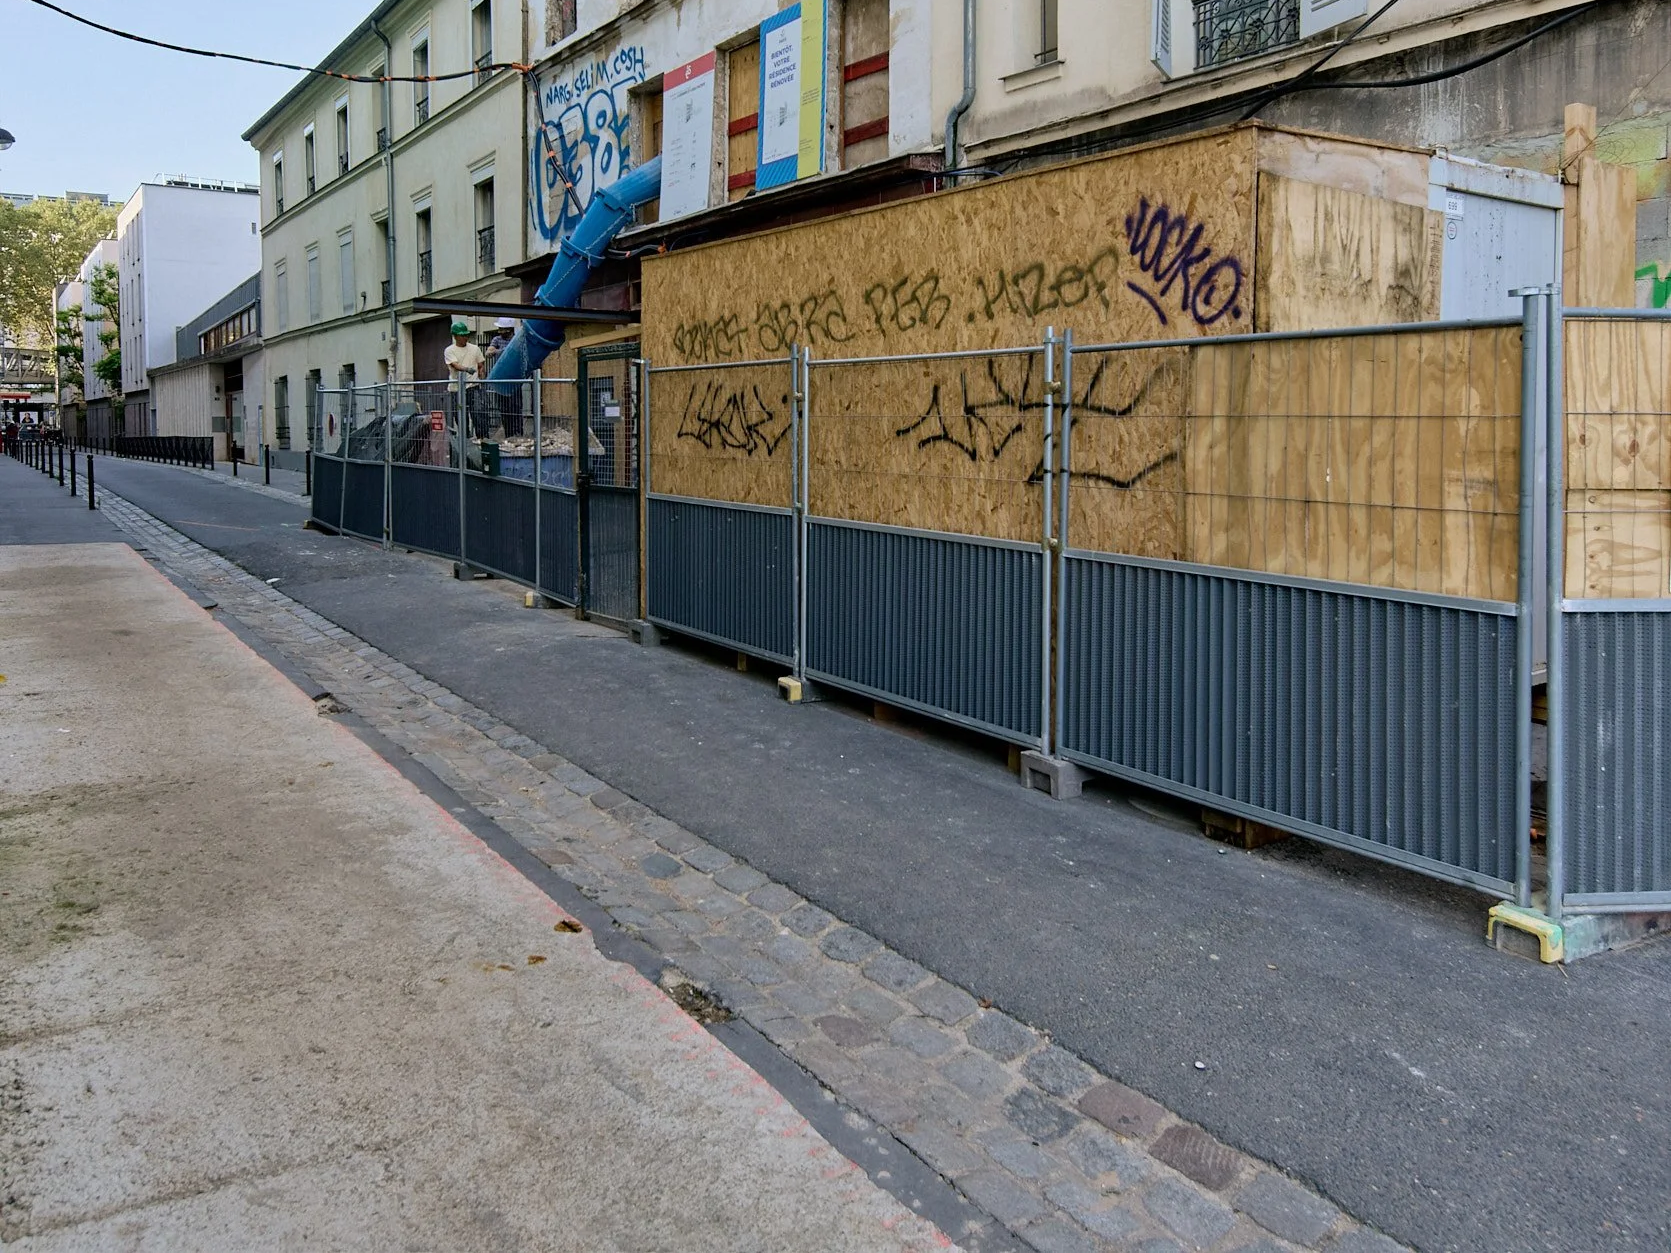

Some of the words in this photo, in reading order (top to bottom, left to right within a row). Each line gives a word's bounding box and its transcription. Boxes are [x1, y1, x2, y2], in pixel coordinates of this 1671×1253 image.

[774, 56, 790, 67] VOTRE
[769, 63, 796, 79] RÉSIDENCE
[771, 74, 794, 87] RÉNOVÉE
